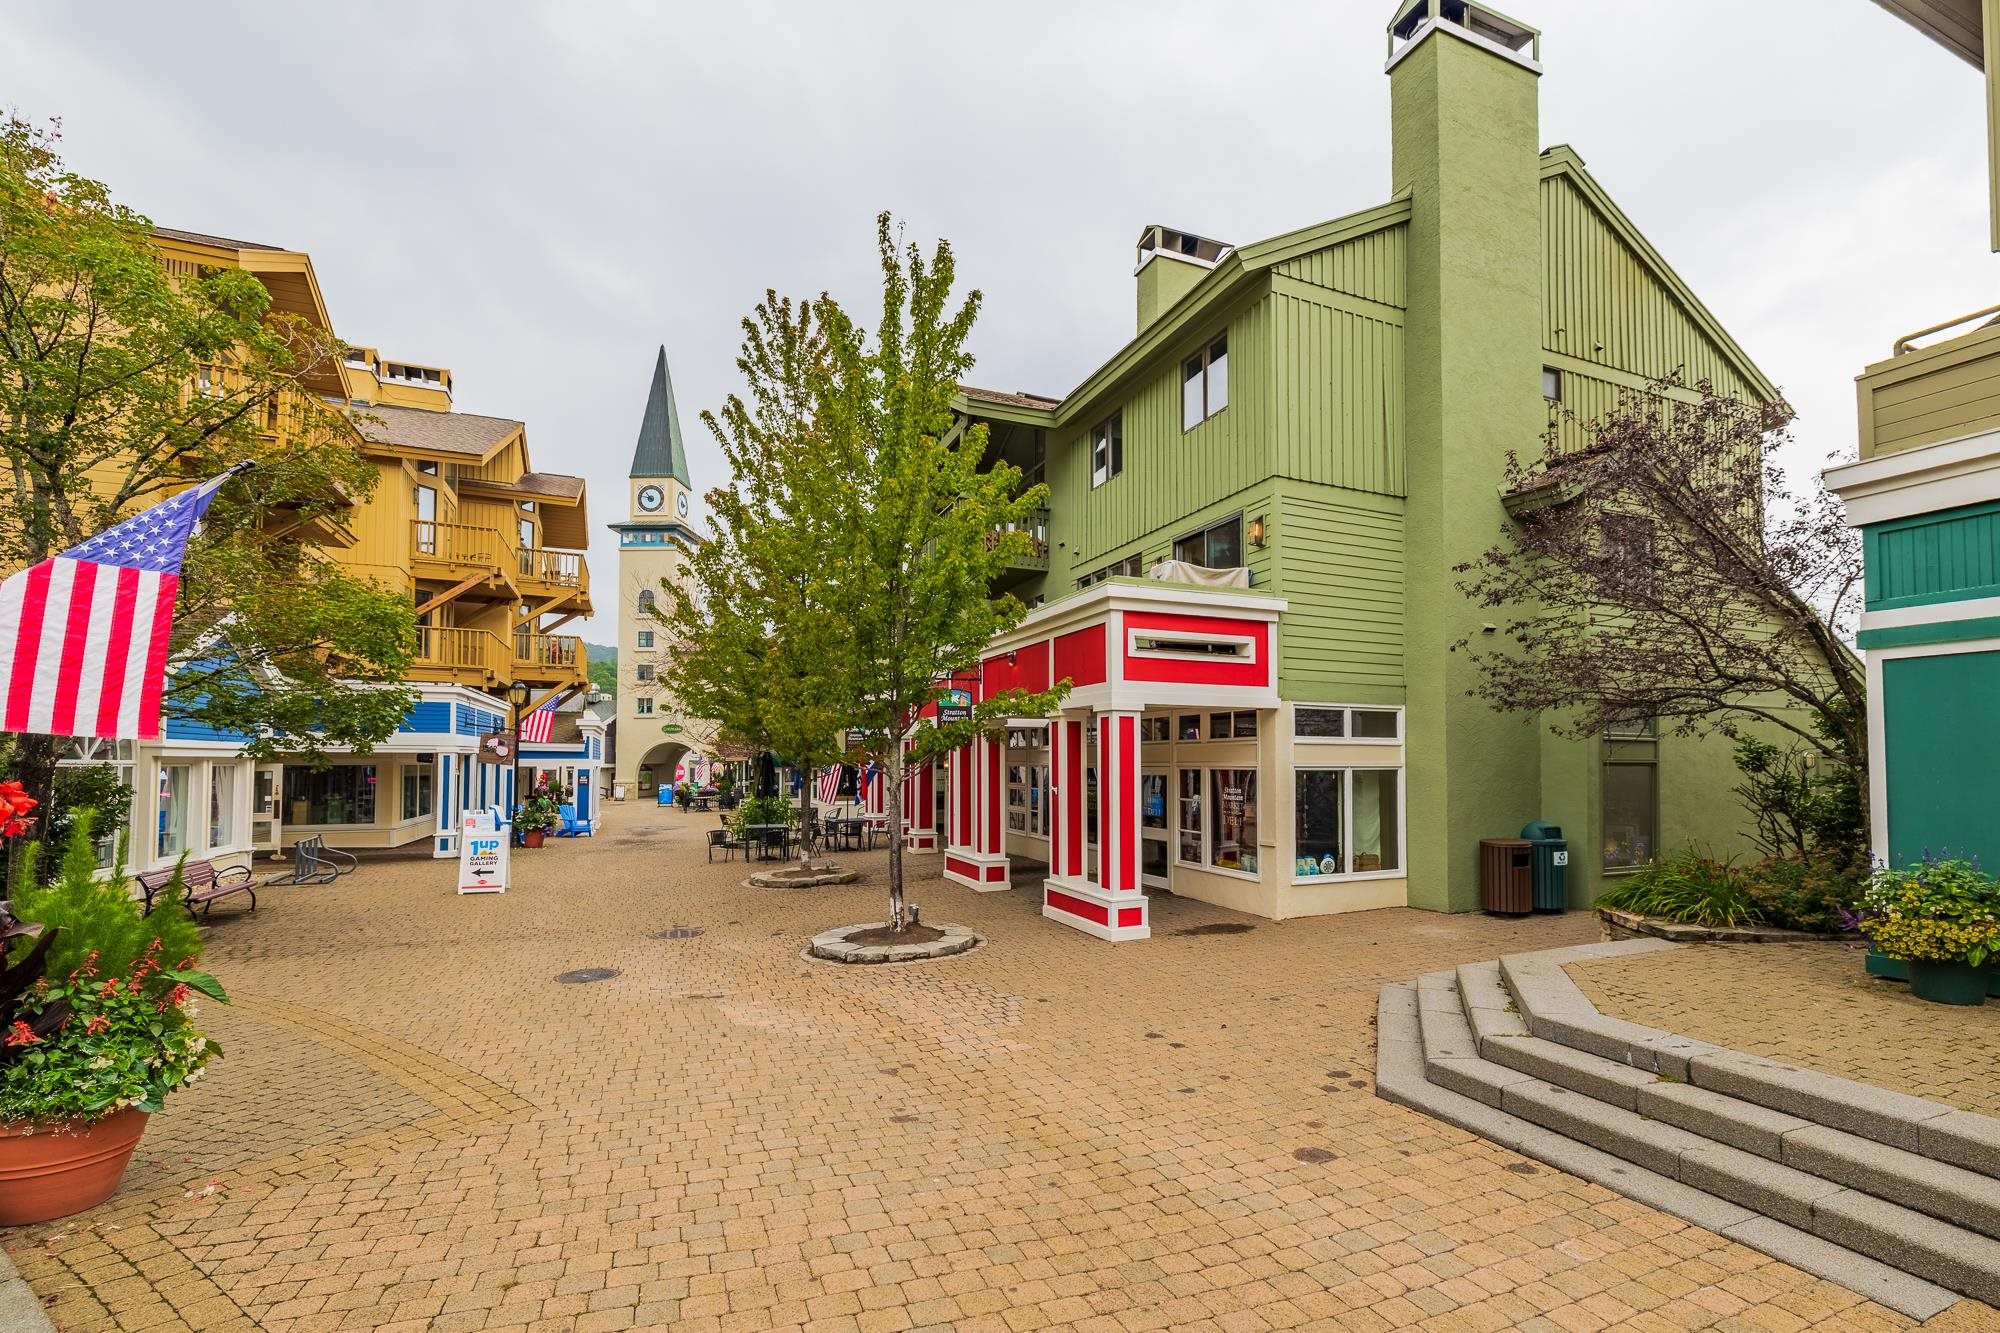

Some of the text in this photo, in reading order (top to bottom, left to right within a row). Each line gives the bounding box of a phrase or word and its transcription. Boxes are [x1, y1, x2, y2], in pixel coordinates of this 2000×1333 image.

[1224, 786, 1242, 794] Stratton
[1223, 815, 1242, 826] DELI
[470, 840, 500, 856] 1up
